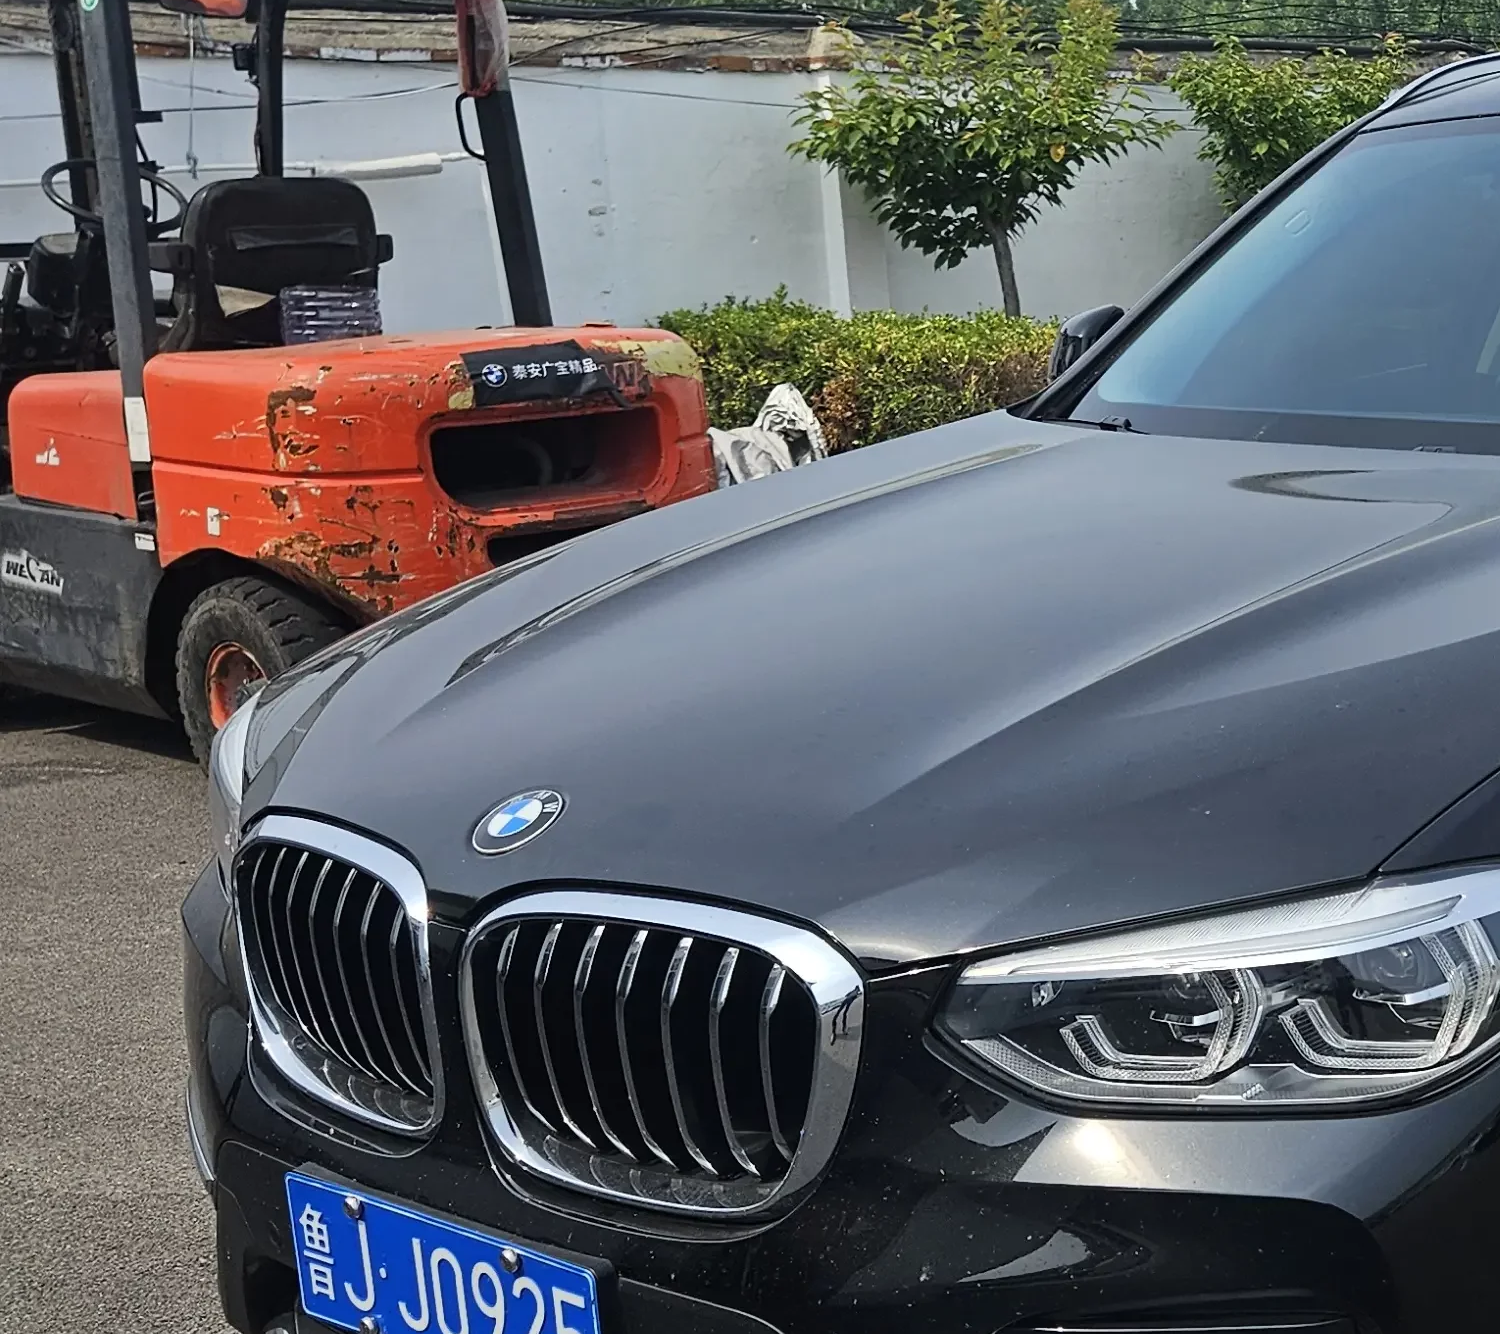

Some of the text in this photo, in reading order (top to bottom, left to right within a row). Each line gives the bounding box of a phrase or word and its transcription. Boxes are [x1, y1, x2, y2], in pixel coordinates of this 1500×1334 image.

[512, 358, 597, 380] 泰安广宝精品
